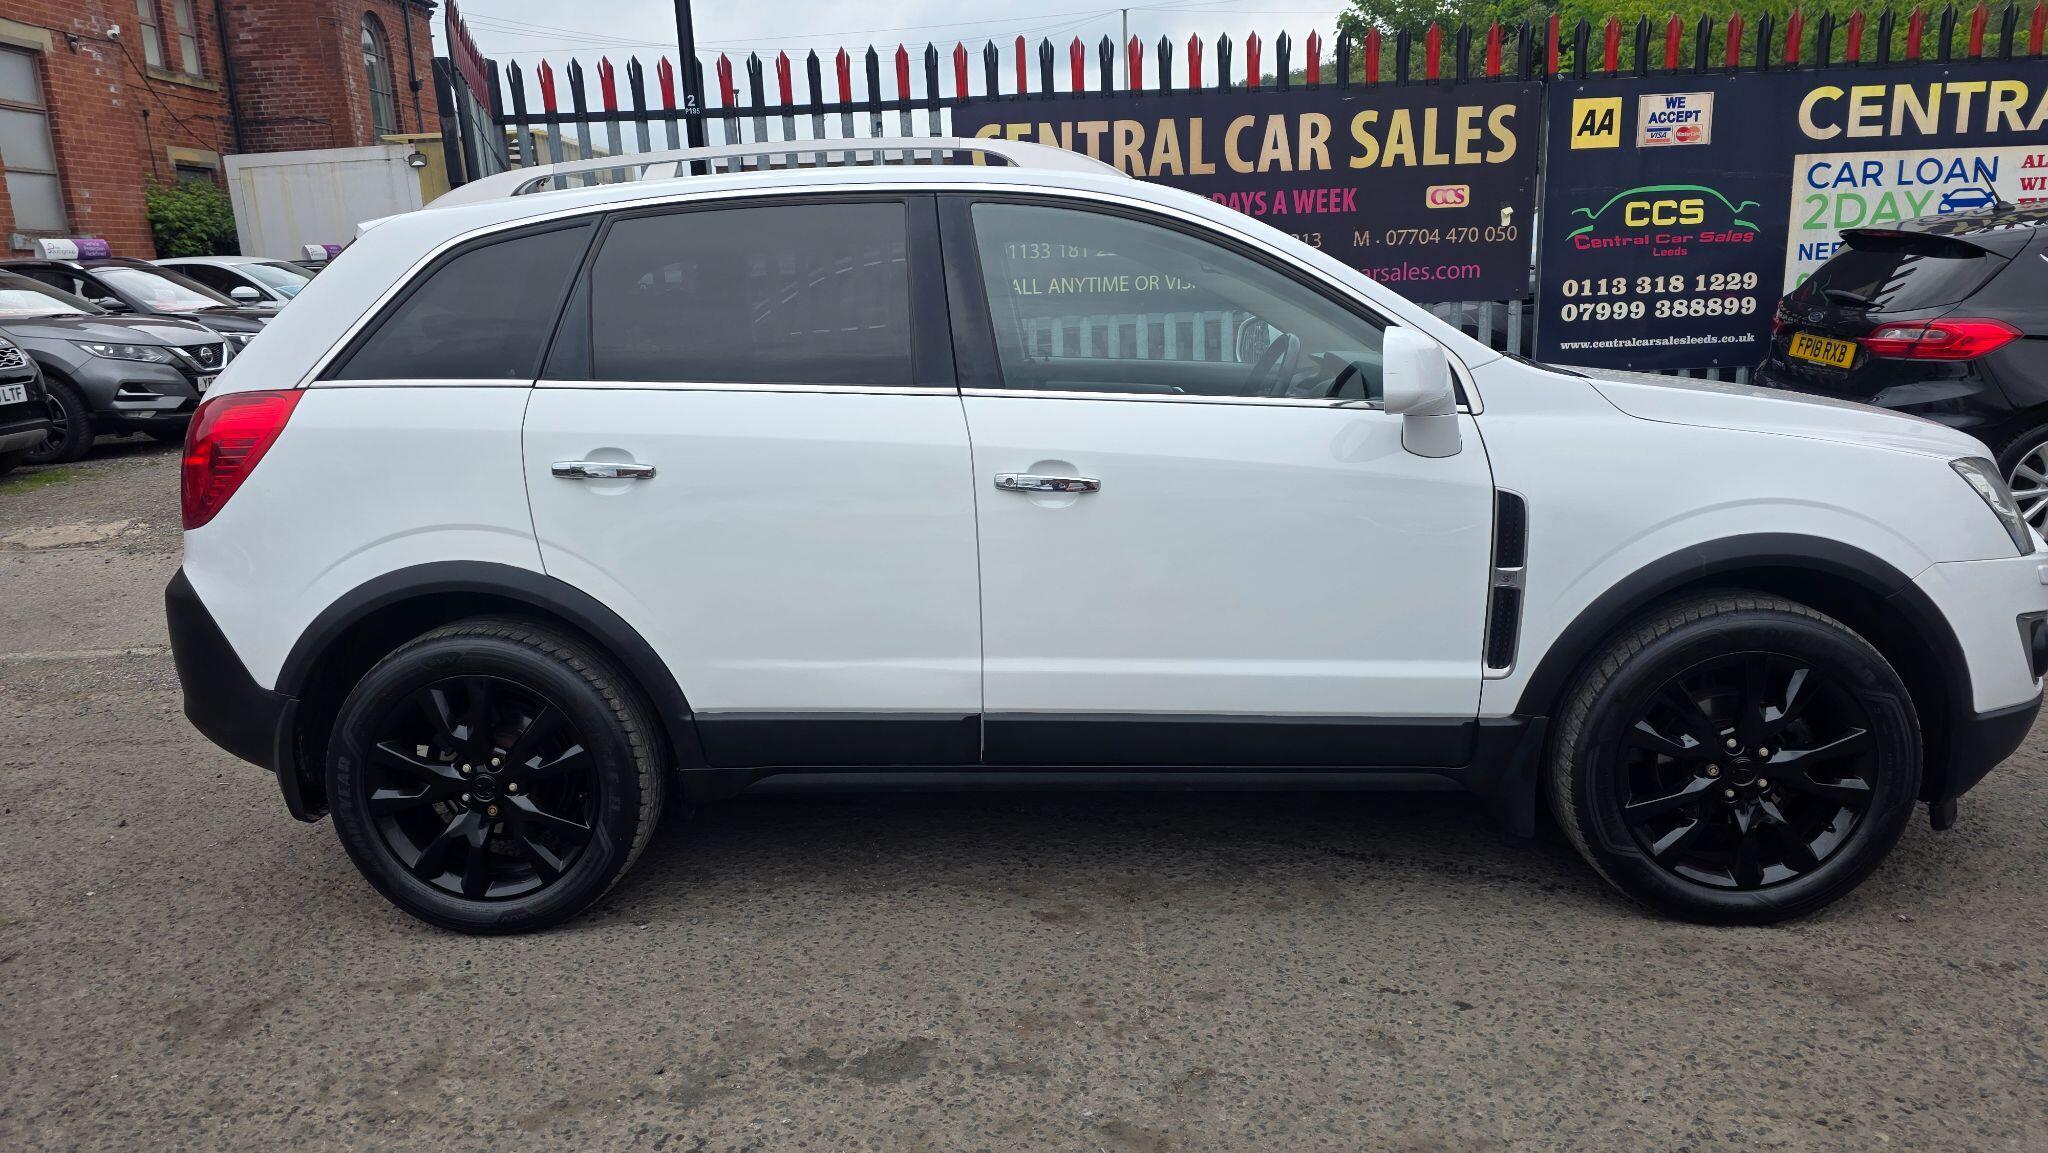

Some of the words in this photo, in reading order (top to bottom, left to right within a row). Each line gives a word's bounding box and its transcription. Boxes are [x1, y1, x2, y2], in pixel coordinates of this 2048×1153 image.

[687, 94, 695, 106] 2
[1665, 96, 1686, 109] WE
[1576, 108, 1614, 137] AA
[1648, 110, 1702, 124] ACCEPT
[971, 117, 1216, 177] TRAL
[1224, 111, 1332, 174] CAR
[1350, 104, 1517, 169] SALES
[1650, 131, 1667, 139] VISA
[1807, 160, 1884, 190] CAR
[1897, 155, 1999, 186] LOAN
[1272, 190, 1288, 215] A
[1292, 187, 1358, 214] WEEK
[1802, 190, 1935, 230] 2DAY
[1625, 199, 1705, 227] CCS
[1386, 228, 1440, 247] 07704
[1446, 227, 1479, 244] 470
[1484, 225, 1518, 242] 050
[1574, 234, 1650, 250] Central
[1655, 233, 1694, 244] Car
[1699, 230, 1755, 243] Sales
[1006, 243, 1050, 259] 1133
[1653, 247, 1688, 257] Leeds
[1048, 275, 1130, 294] ANYTIME
[1135, 275, 1160, 291] OR
[1562, 277, 1627, 297] 0113
[1635, 275, 1685, 294] 318
[1695, 272, 1758, 292] 1229
[1561, 301, 1646, 322] 07999
[1654, 297, 1757, 318] 388899
[1560, 333, 1755, 350] www.centralcarsalesleeds.co.uk
[1796, 336, 1822, 357] FP18
[1822, 341, 1848, 362] RXB
